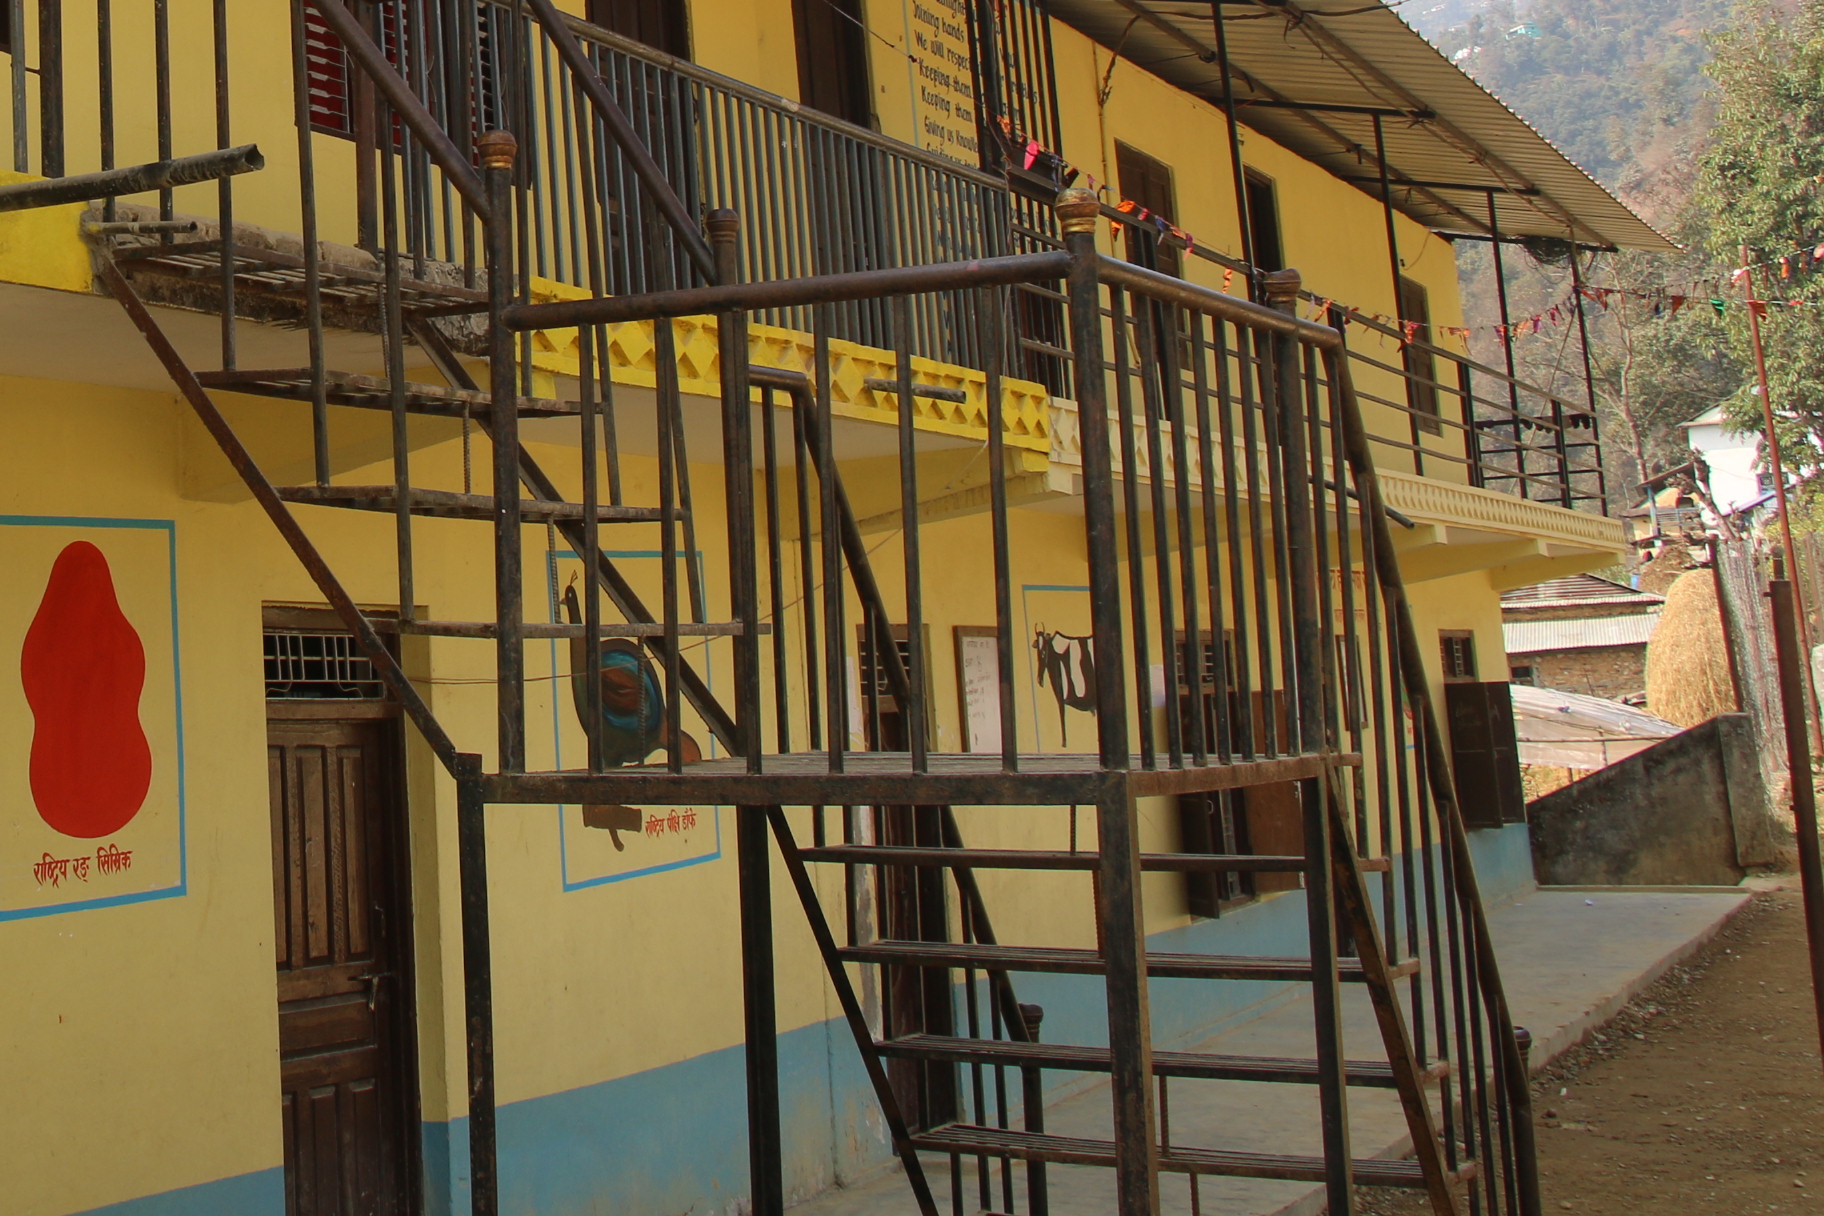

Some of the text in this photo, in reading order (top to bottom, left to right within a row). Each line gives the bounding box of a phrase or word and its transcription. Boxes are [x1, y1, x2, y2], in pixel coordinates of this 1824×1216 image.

[942, 17, 964, 43] hands
[914, 29, 970, 71] We will respec
[919, 57, 950, 94] Keeping
[921, 85, 974, 123] Keeping them
[924, 115, 944, 146] Giving
[946, 129, 955, 144] us
[33, 852, 71, 888] राष्ट्रिय
